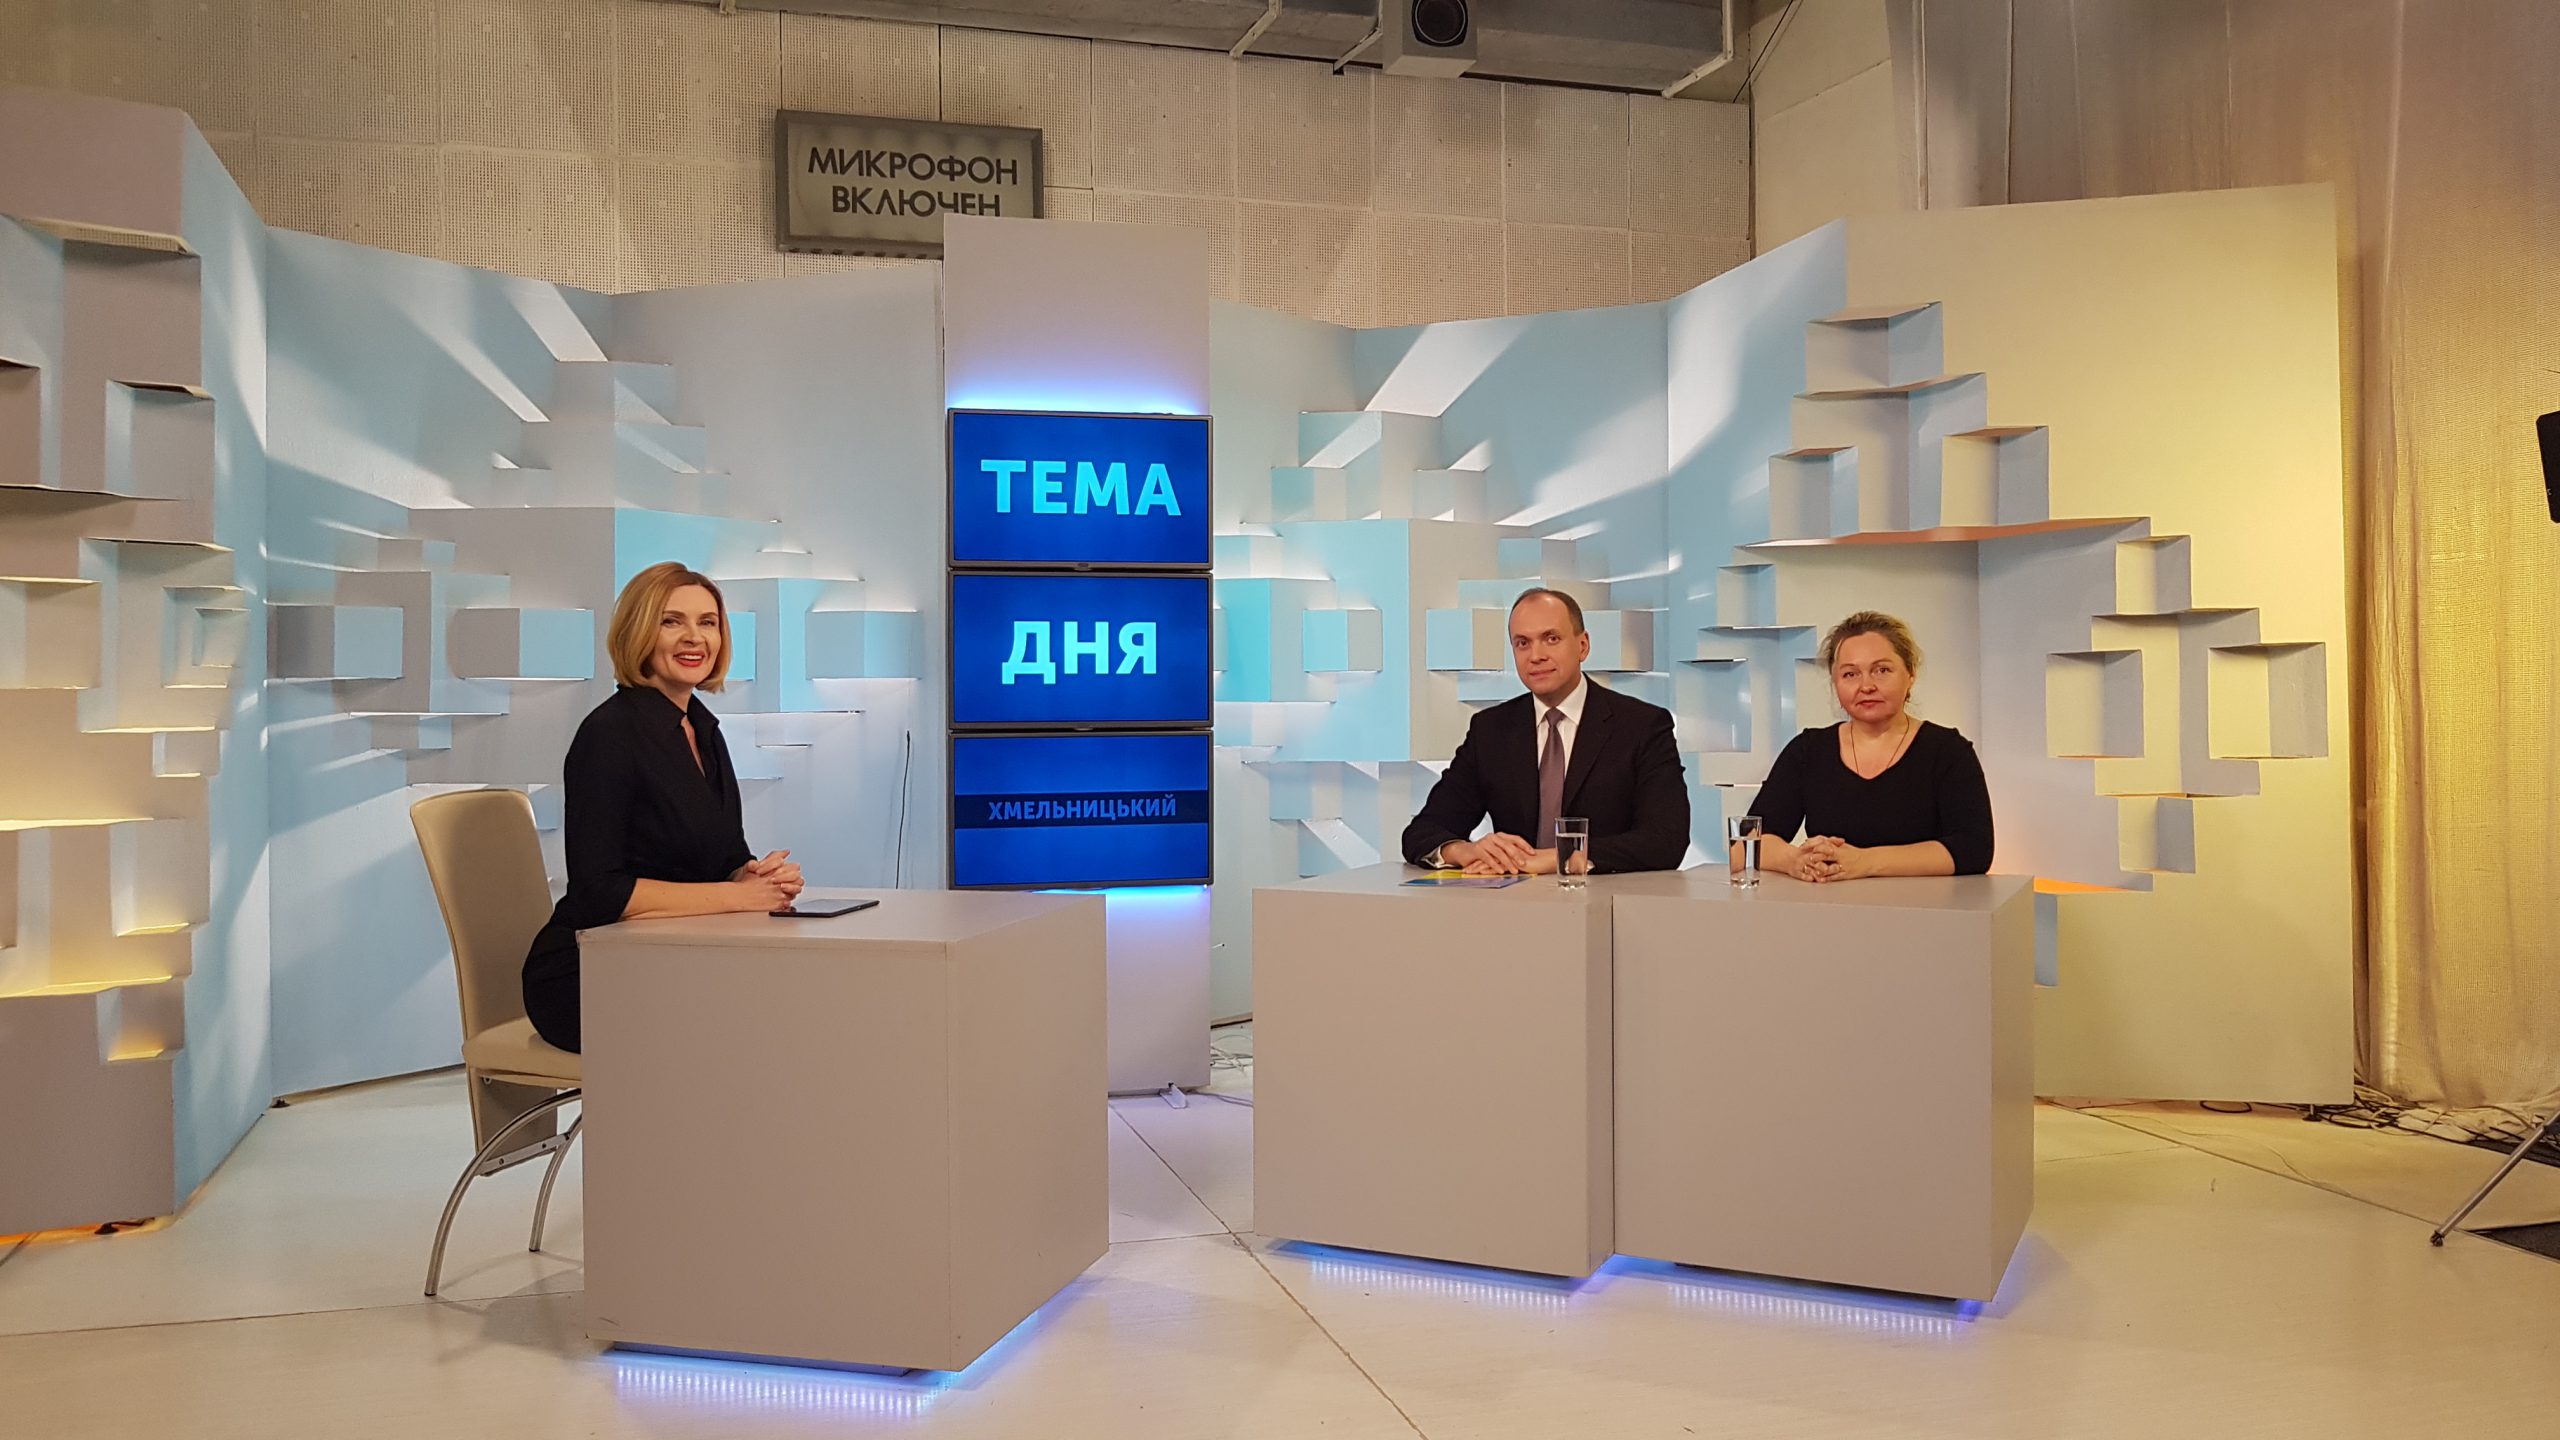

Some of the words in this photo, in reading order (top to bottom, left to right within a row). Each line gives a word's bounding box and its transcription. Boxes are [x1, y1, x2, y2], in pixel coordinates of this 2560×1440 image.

[808, 146, 1018, 185] МИКРОФОН
[832, 185, 1001, 217] ВКЛЮЧЕН
[980, 459, 1182, 516] ТЕМА
[1001, 620, 1157, 685] ДНЯ
[988, 794, 1177, 821] ХМЕЛЬНИЦЬКИЙ
